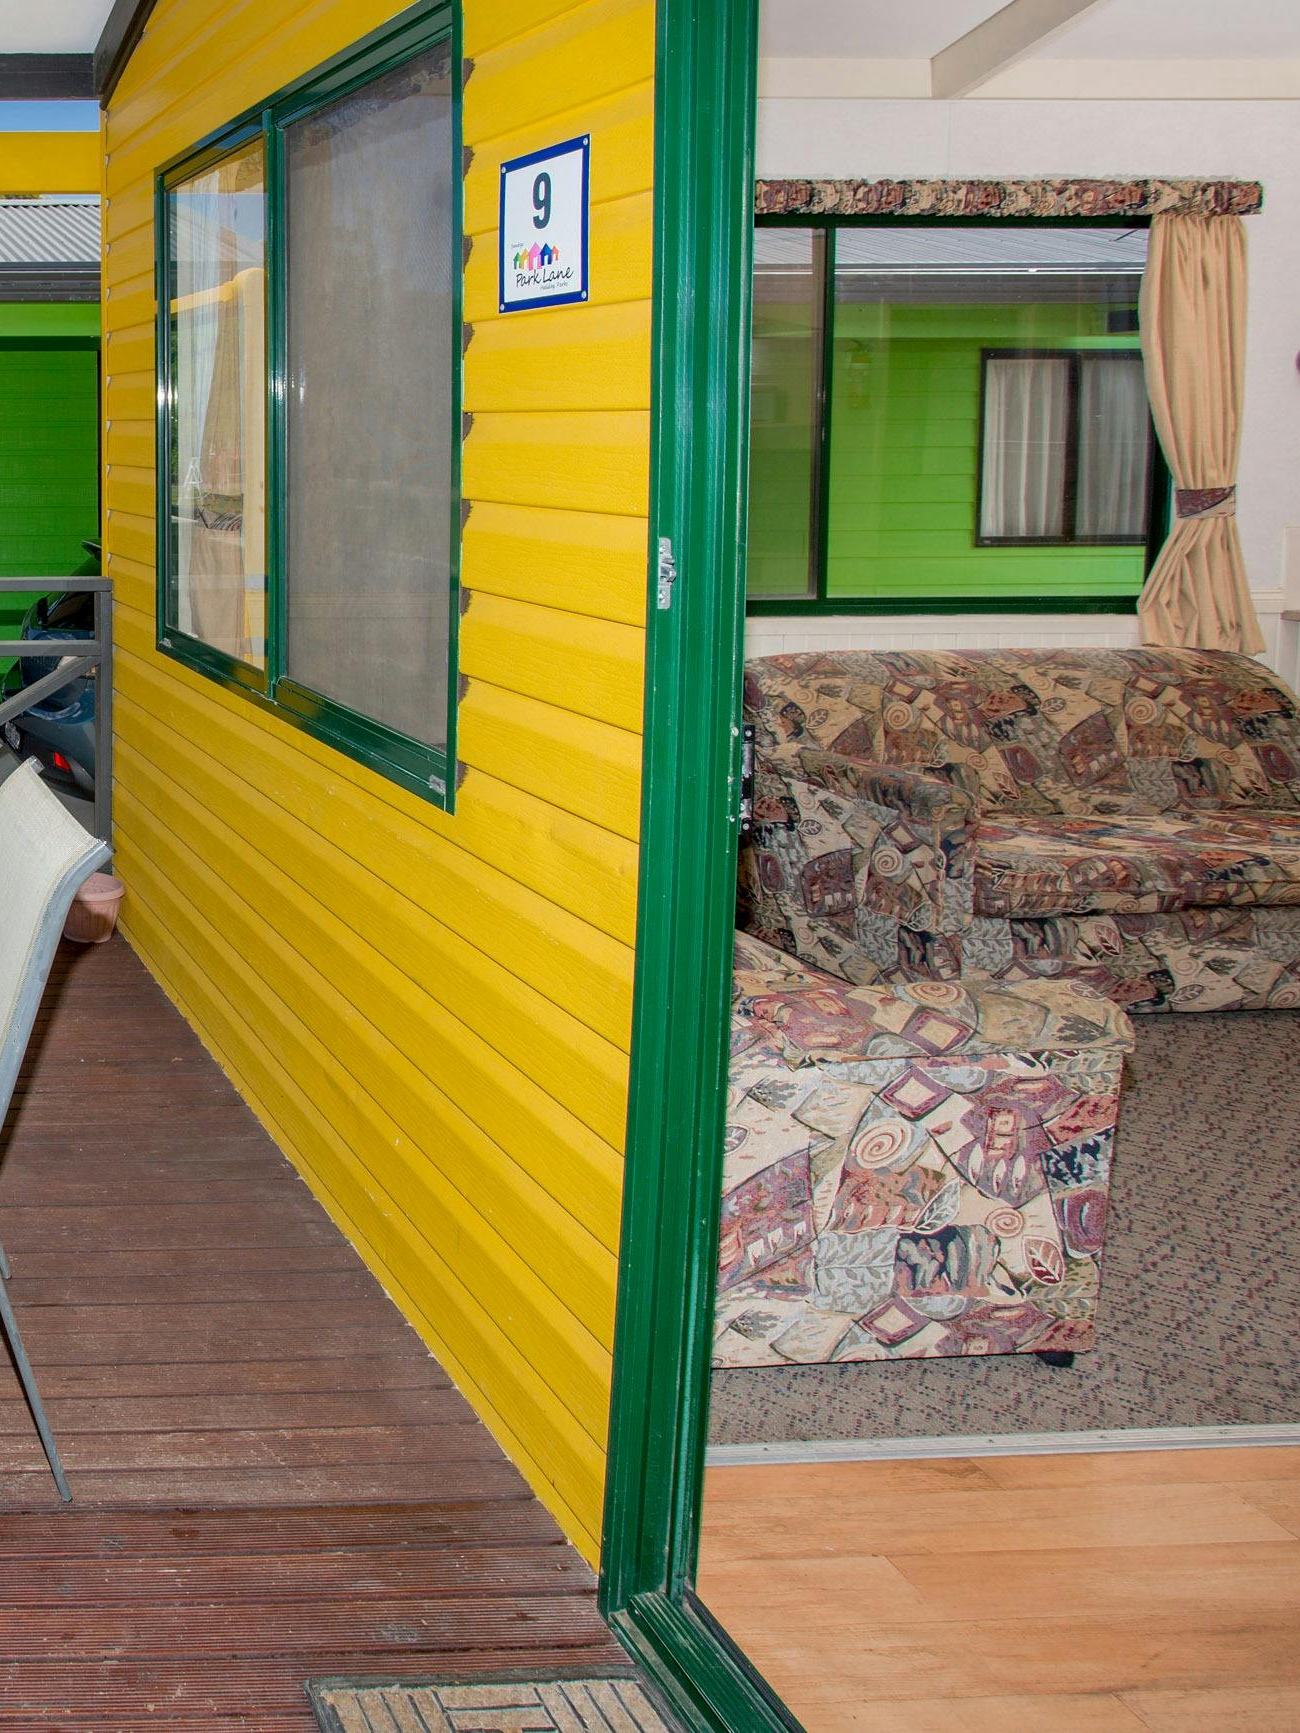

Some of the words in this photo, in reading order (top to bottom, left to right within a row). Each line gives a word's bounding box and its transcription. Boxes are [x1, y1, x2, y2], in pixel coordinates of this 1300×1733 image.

[533, 172, 551, 229] 9
[516, 269, 541, 287] Park
[543, 267, 573, 283] Lane
